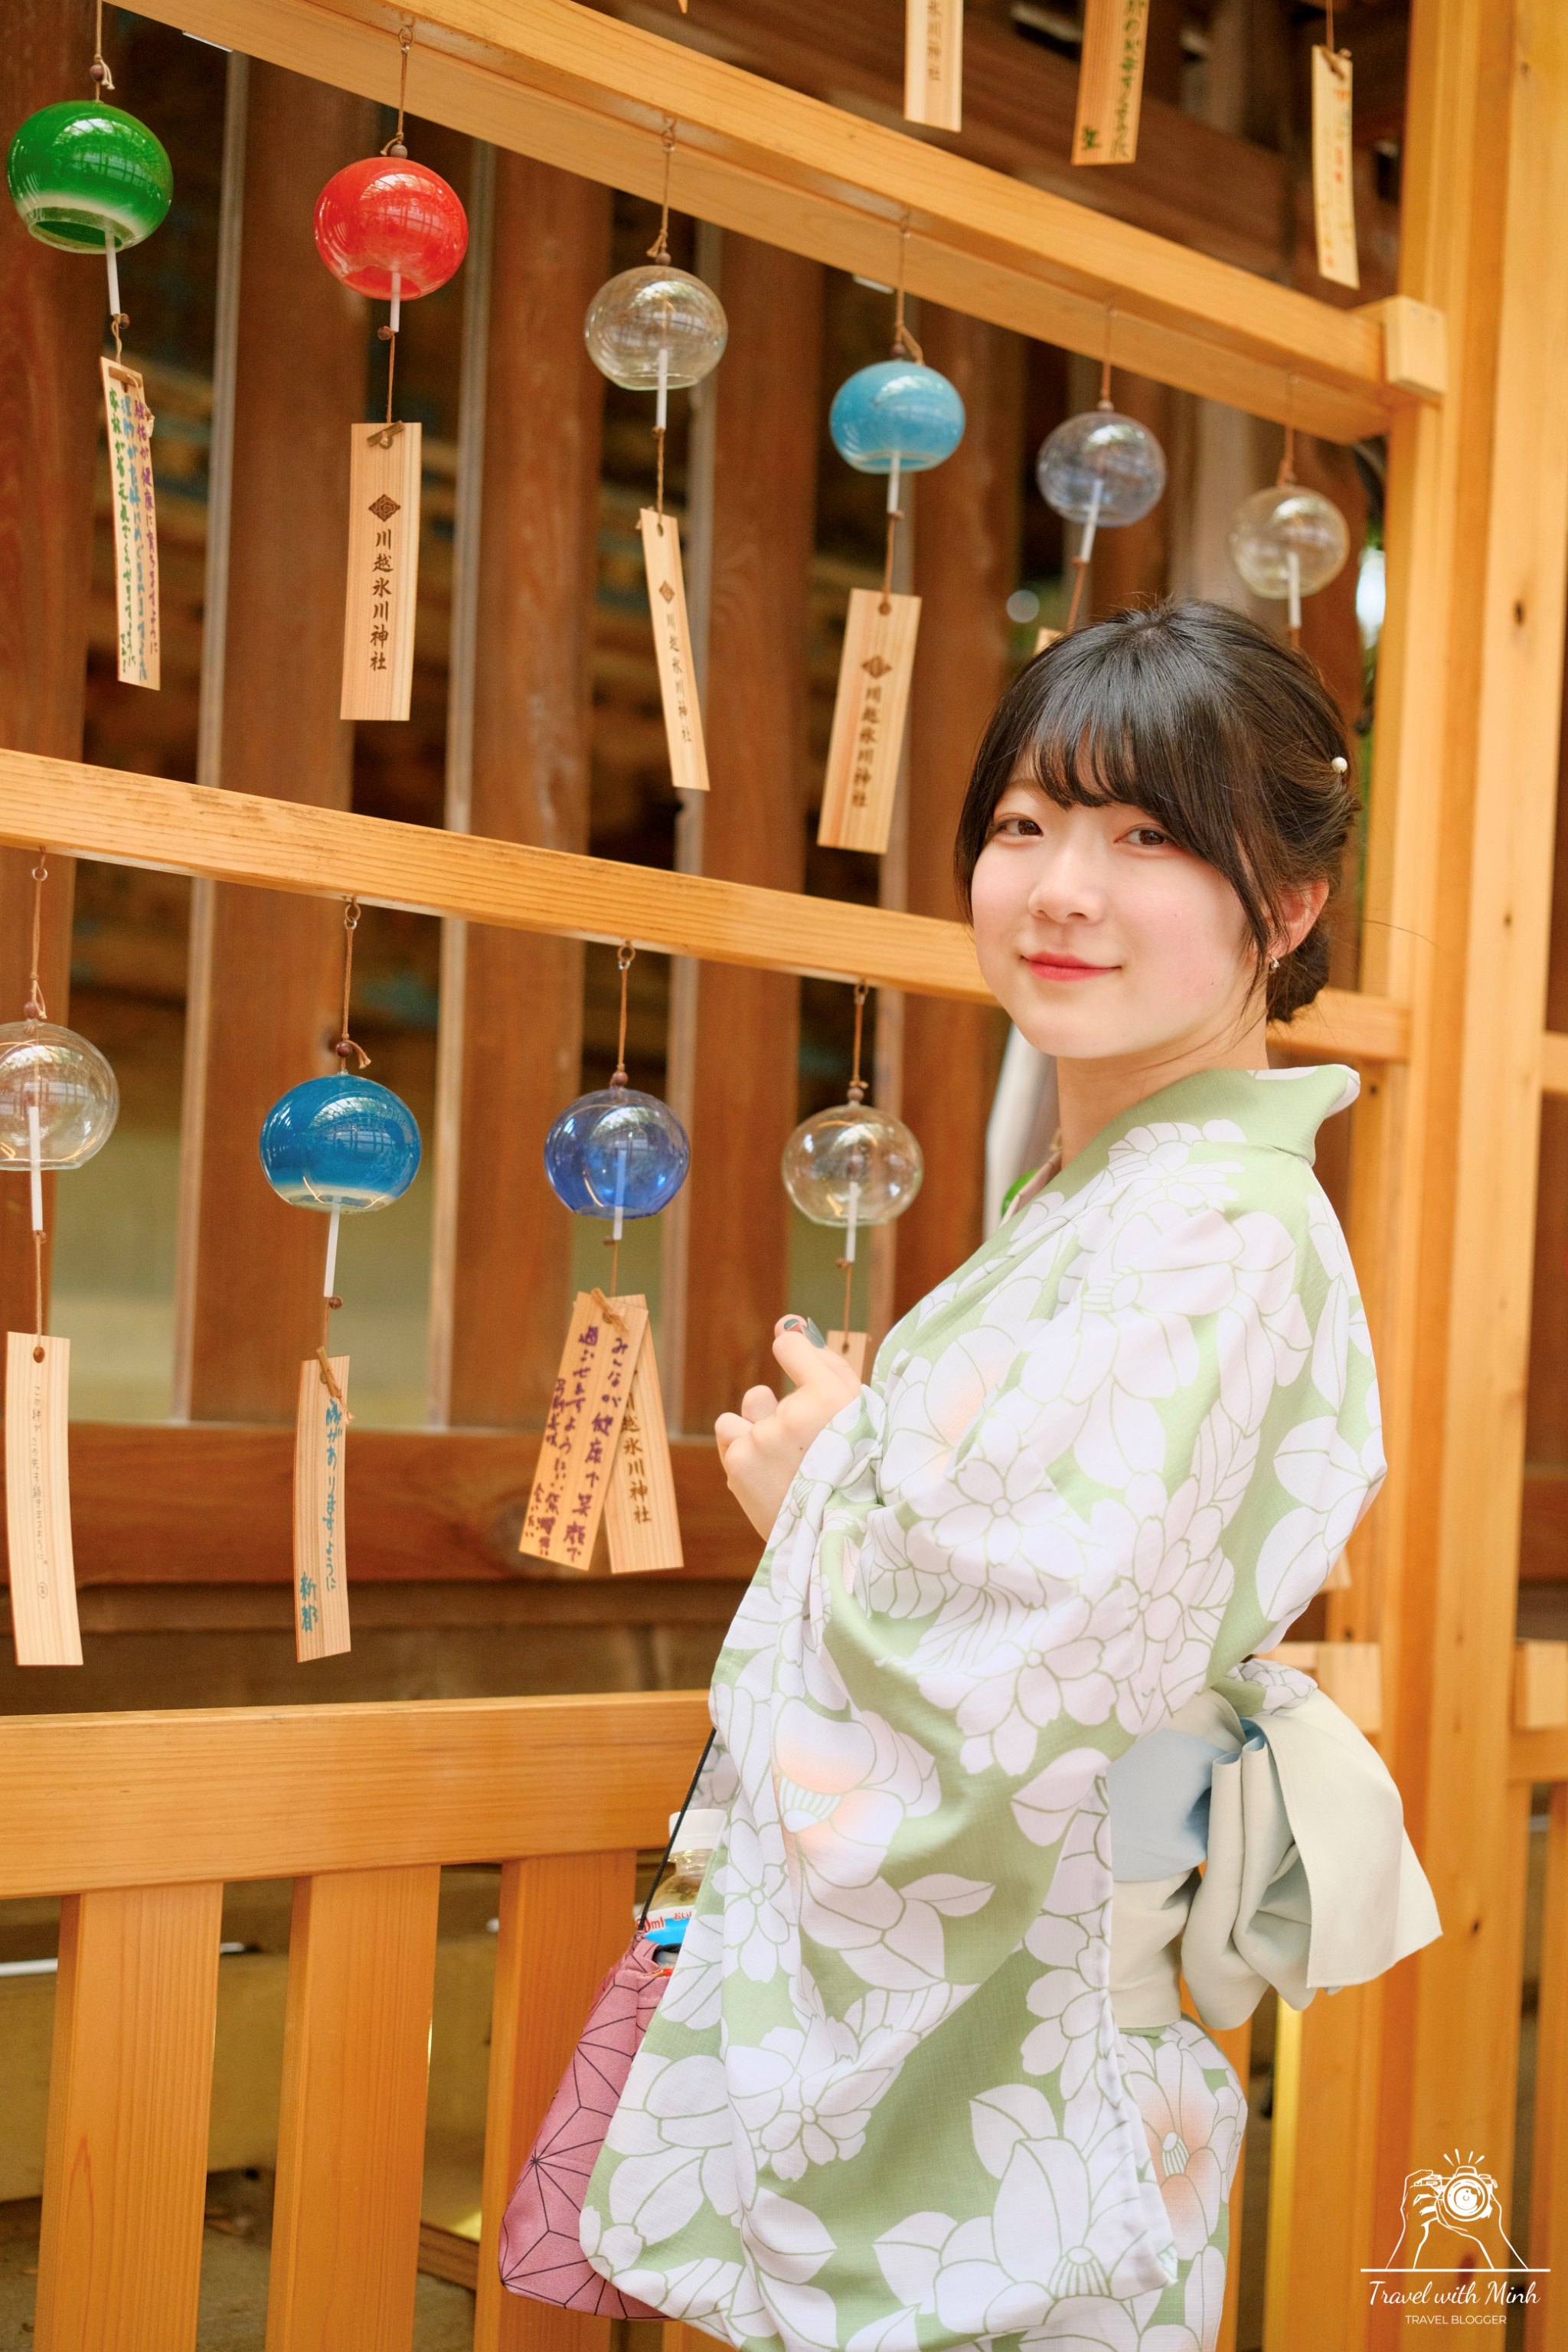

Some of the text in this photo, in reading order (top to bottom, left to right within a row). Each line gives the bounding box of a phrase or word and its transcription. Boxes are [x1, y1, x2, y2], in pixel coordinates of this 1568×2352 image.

[370, 528, 394, 671] 川越氷川神社
[851, 686, 882, 808] 川越氷川神社
